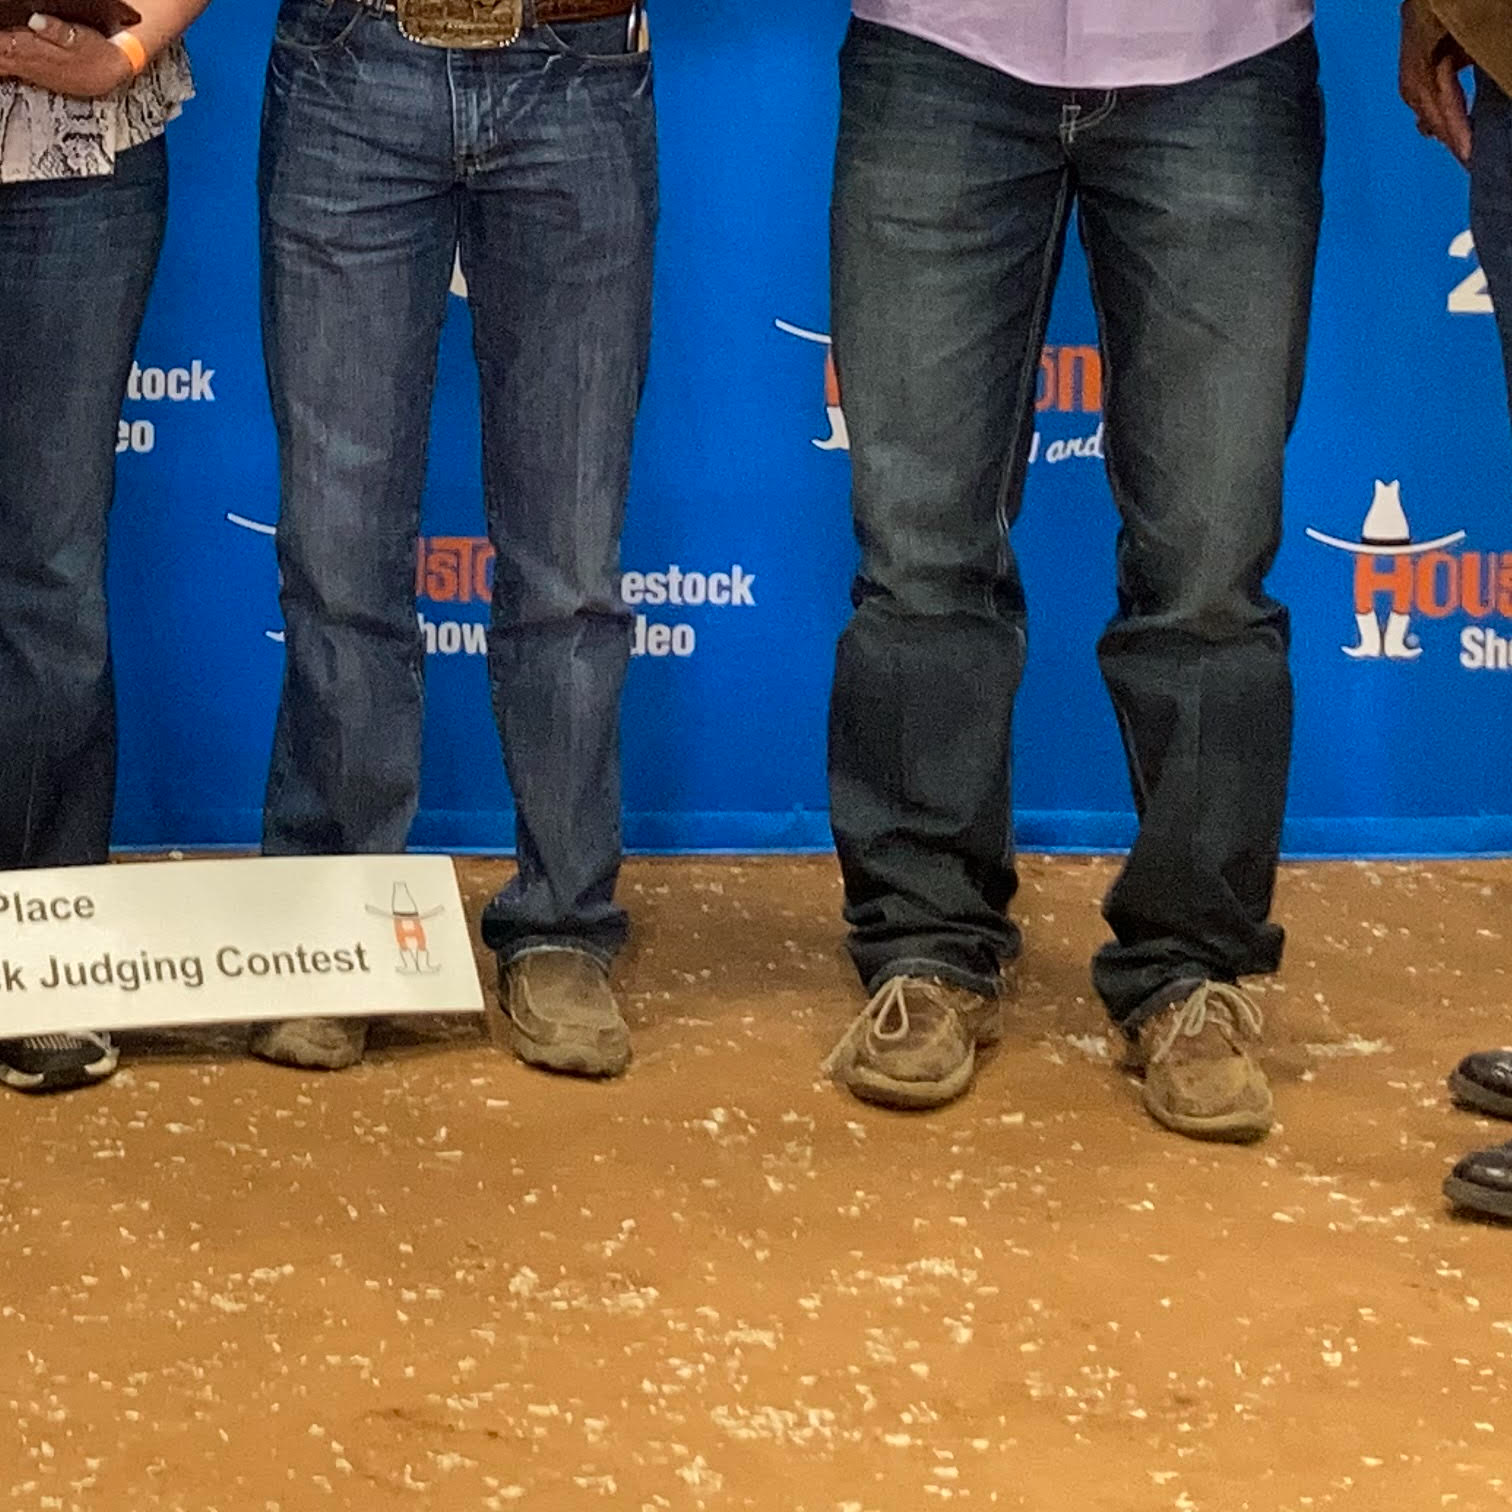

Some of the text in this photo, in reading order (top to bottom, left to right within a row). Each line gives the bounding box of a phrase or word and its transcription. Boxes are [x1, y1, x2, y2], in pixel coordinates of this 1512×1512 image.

[620, 564, 757, 607] estock
[418, 613, 489, 656] how
[1459, 625, 1512, 671] Sh
[39, 954, 205, 991] Judging
[215, 943, 370, 978] Contest
